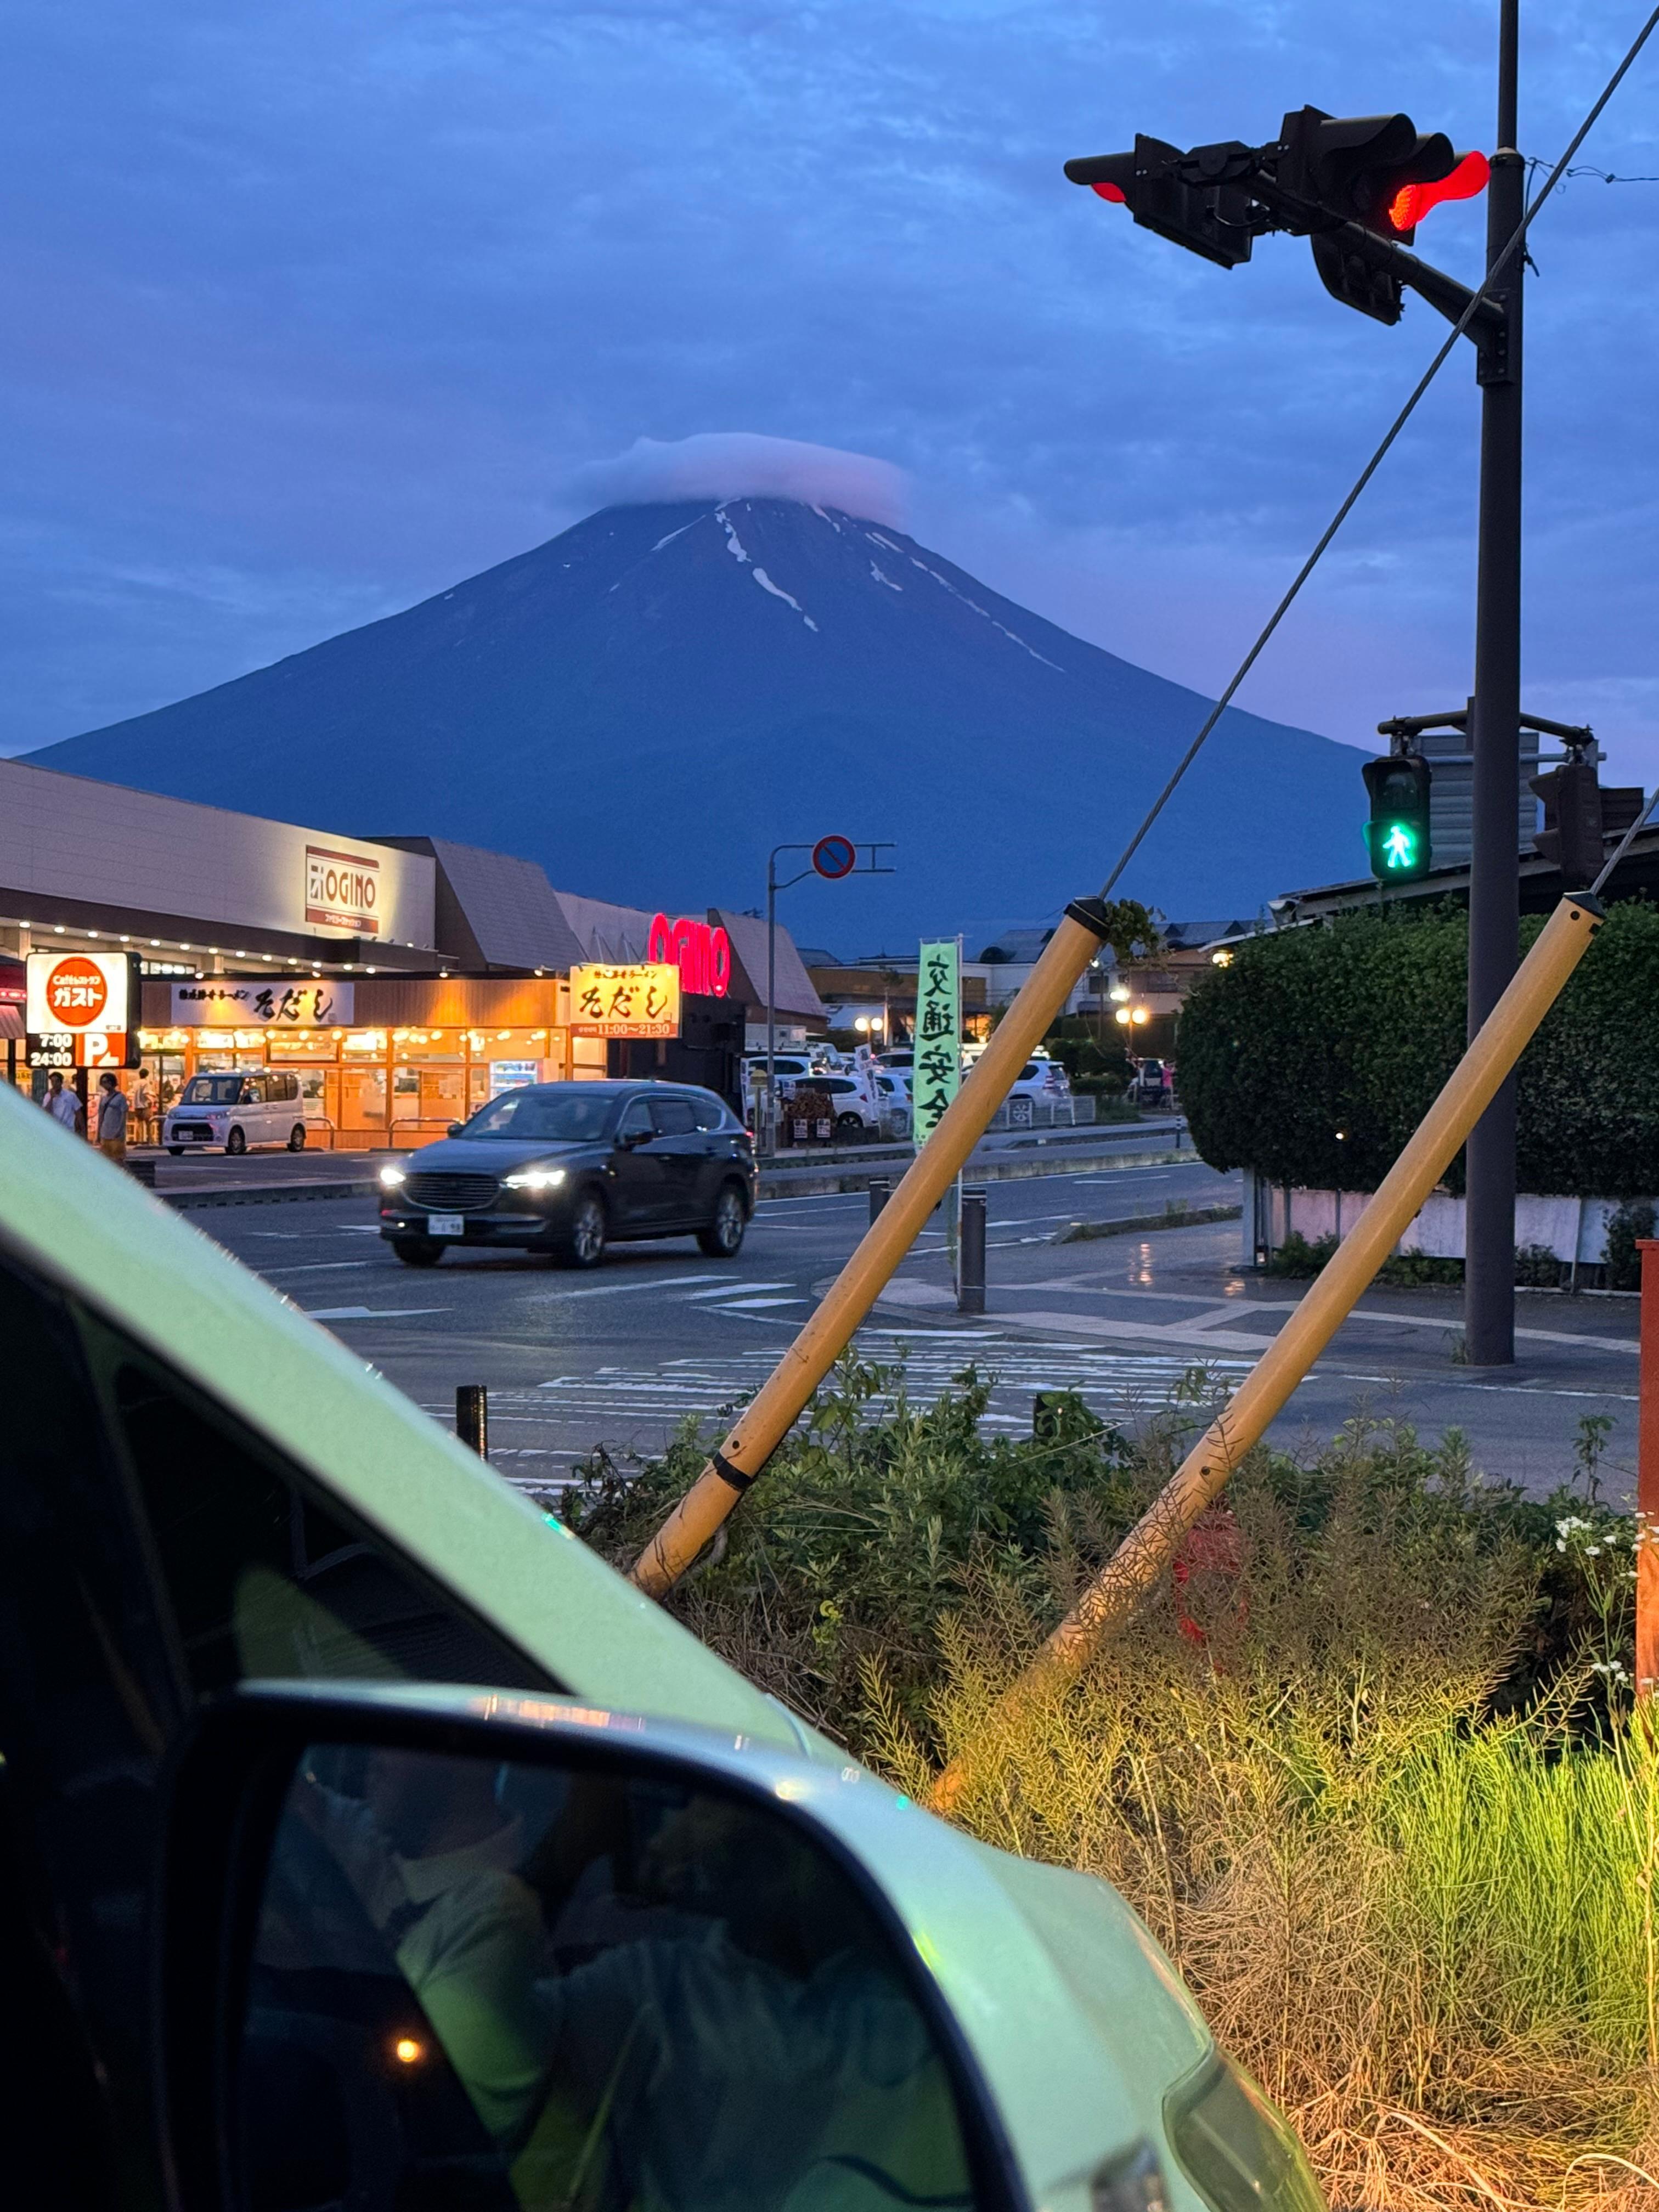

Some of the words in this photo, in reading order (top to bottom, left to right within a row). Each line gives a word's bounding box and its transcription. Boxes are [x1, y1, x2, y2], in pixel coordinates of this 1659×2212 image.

[326, 869, 376, 909] OGINO
[54, 986, 103, 1007] ガスト
[39, 1033, 73, 1048] 7:00
[83, 1033, 109, 1067] P
[30, 1052, 73, 1066] 24:00
